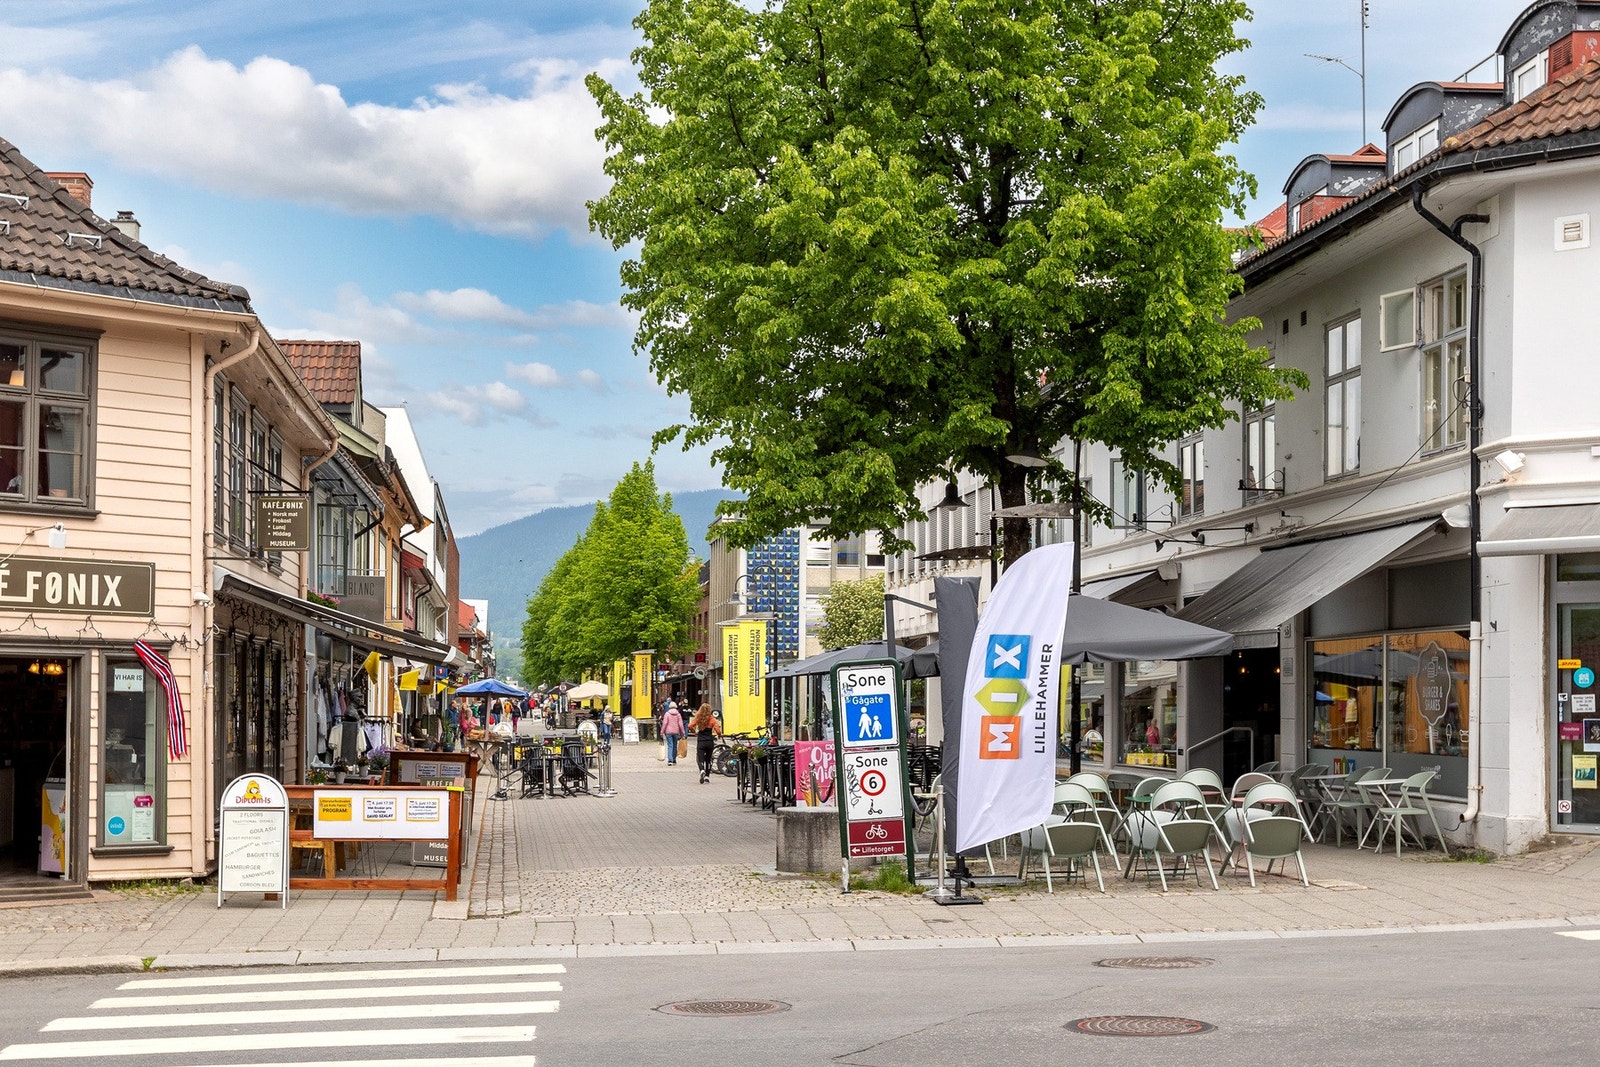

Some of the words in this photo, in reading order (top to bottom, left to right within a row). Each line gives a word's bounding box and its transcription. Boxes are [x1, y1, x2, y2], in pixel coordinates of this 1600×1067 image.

[262, 501, 280, 509] KAFÉ
[27, 570, 122, 607] FØNIX
[348, 582, 374, 596] BLANC
[848, 674, 886, 687] Sone
[852, 696, 884, 706] Gågate
[987, 643, 1022, 752] MIX
[1034, 644, 1054, 754] LILLEHAMMER
[811, 746, 835, 769] Op
[856, 756, 888, 768] Sone
[869, 777, 877, 789] 6
[862, 846, 894, 854] Lilletorget
[242, 870, 275, 879] SANDWICHES
